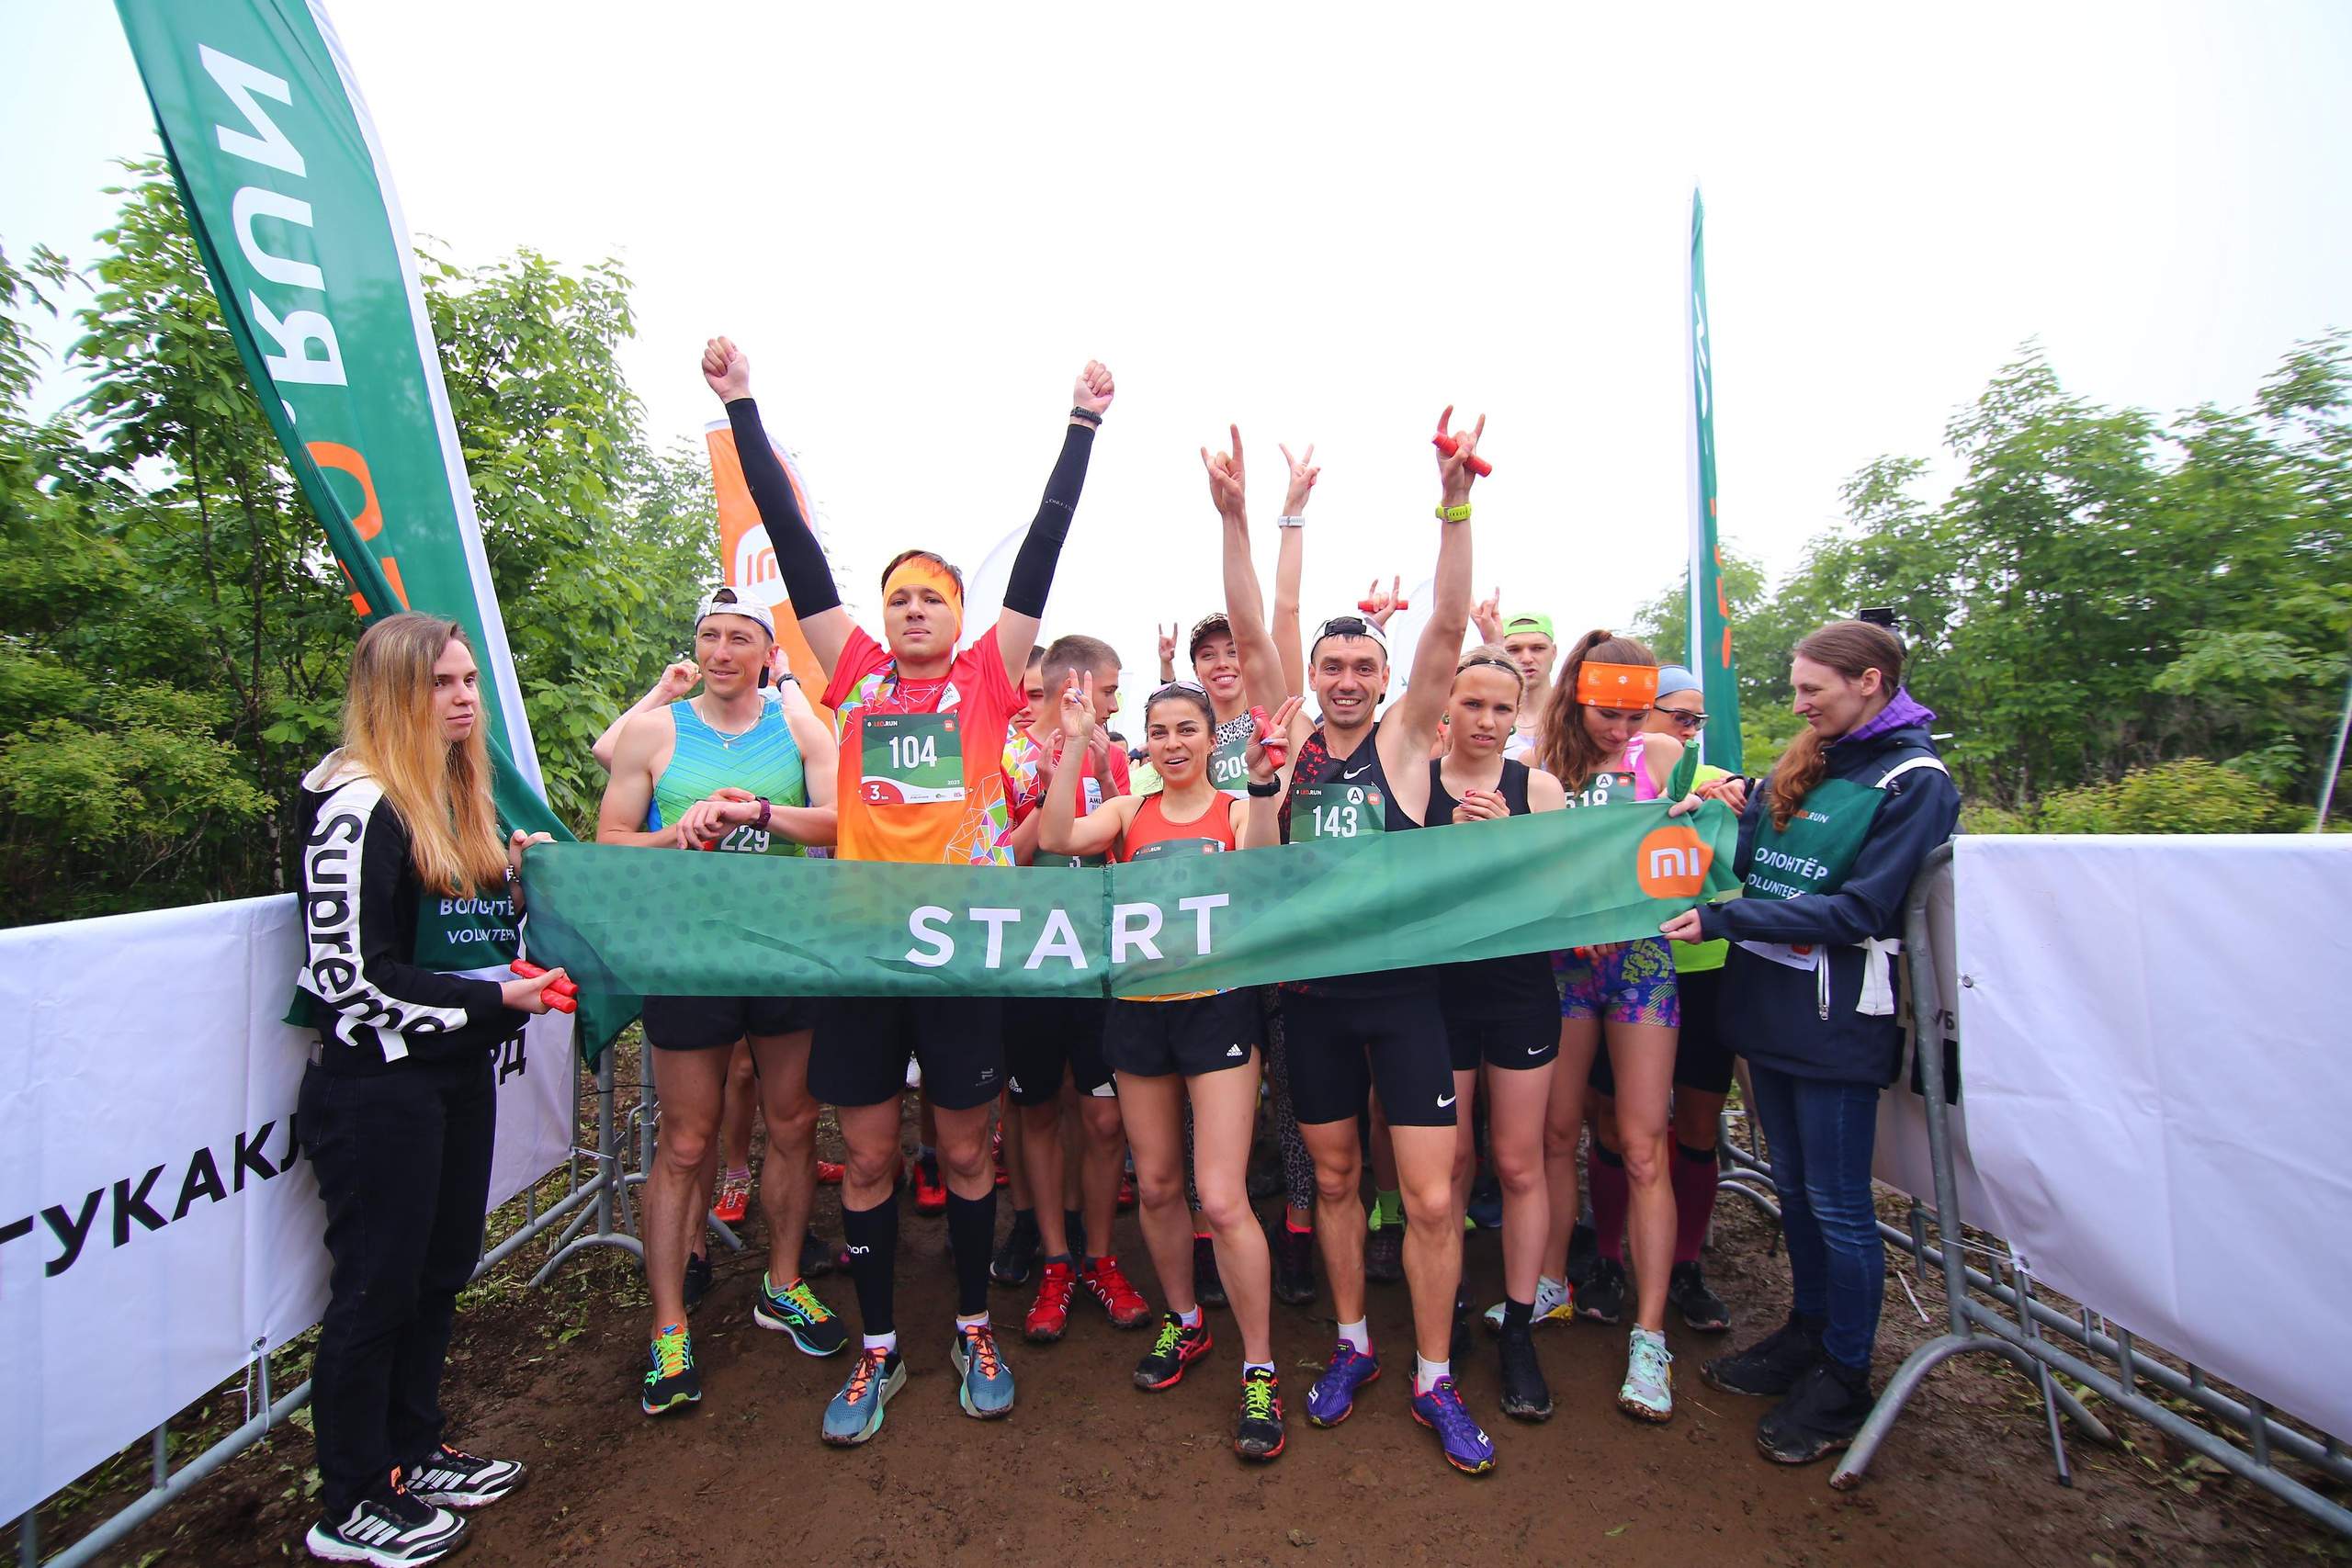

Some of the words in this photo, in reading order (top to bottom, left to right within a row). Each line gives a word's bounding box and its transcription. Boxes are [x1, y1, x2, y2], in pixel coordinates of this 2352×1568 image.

[888, 735, 938, 769] 104
[869, 784, 880, 801] 3
[1599, 775, 1610, 785] A
[1089, 796, 1102, 805] AMU
[1350, 789, 1362, 802] A
[1312, 805, 1358, 838] 143
[720, 825, 770, 853] 229
[1754, 846, 1829, 881] ОЛОНТЁР
[904, 893, 1230, 970] START
